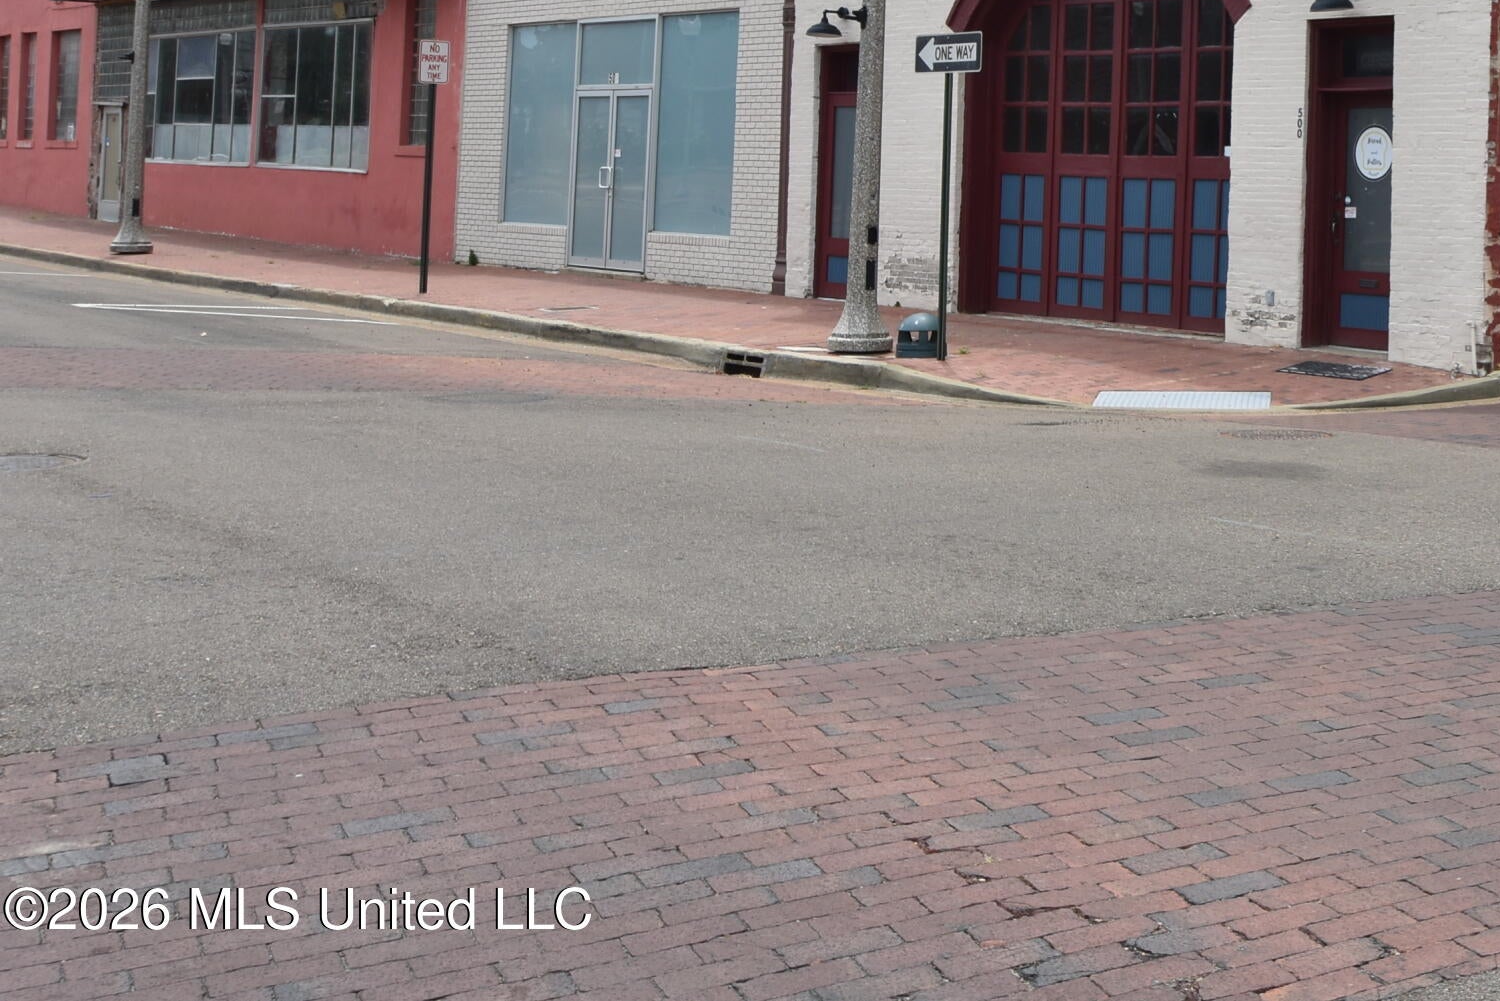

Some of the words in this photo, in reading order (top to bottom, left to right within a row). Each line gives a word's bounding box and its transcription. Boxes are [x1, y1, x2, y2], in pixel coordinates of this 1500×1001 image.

[429, 44, 440, 53] NO
[934, 46, 953, 61] ONE
[955, 44, 974, 60] WAY
[421, 54, 448, 63] PARKING
